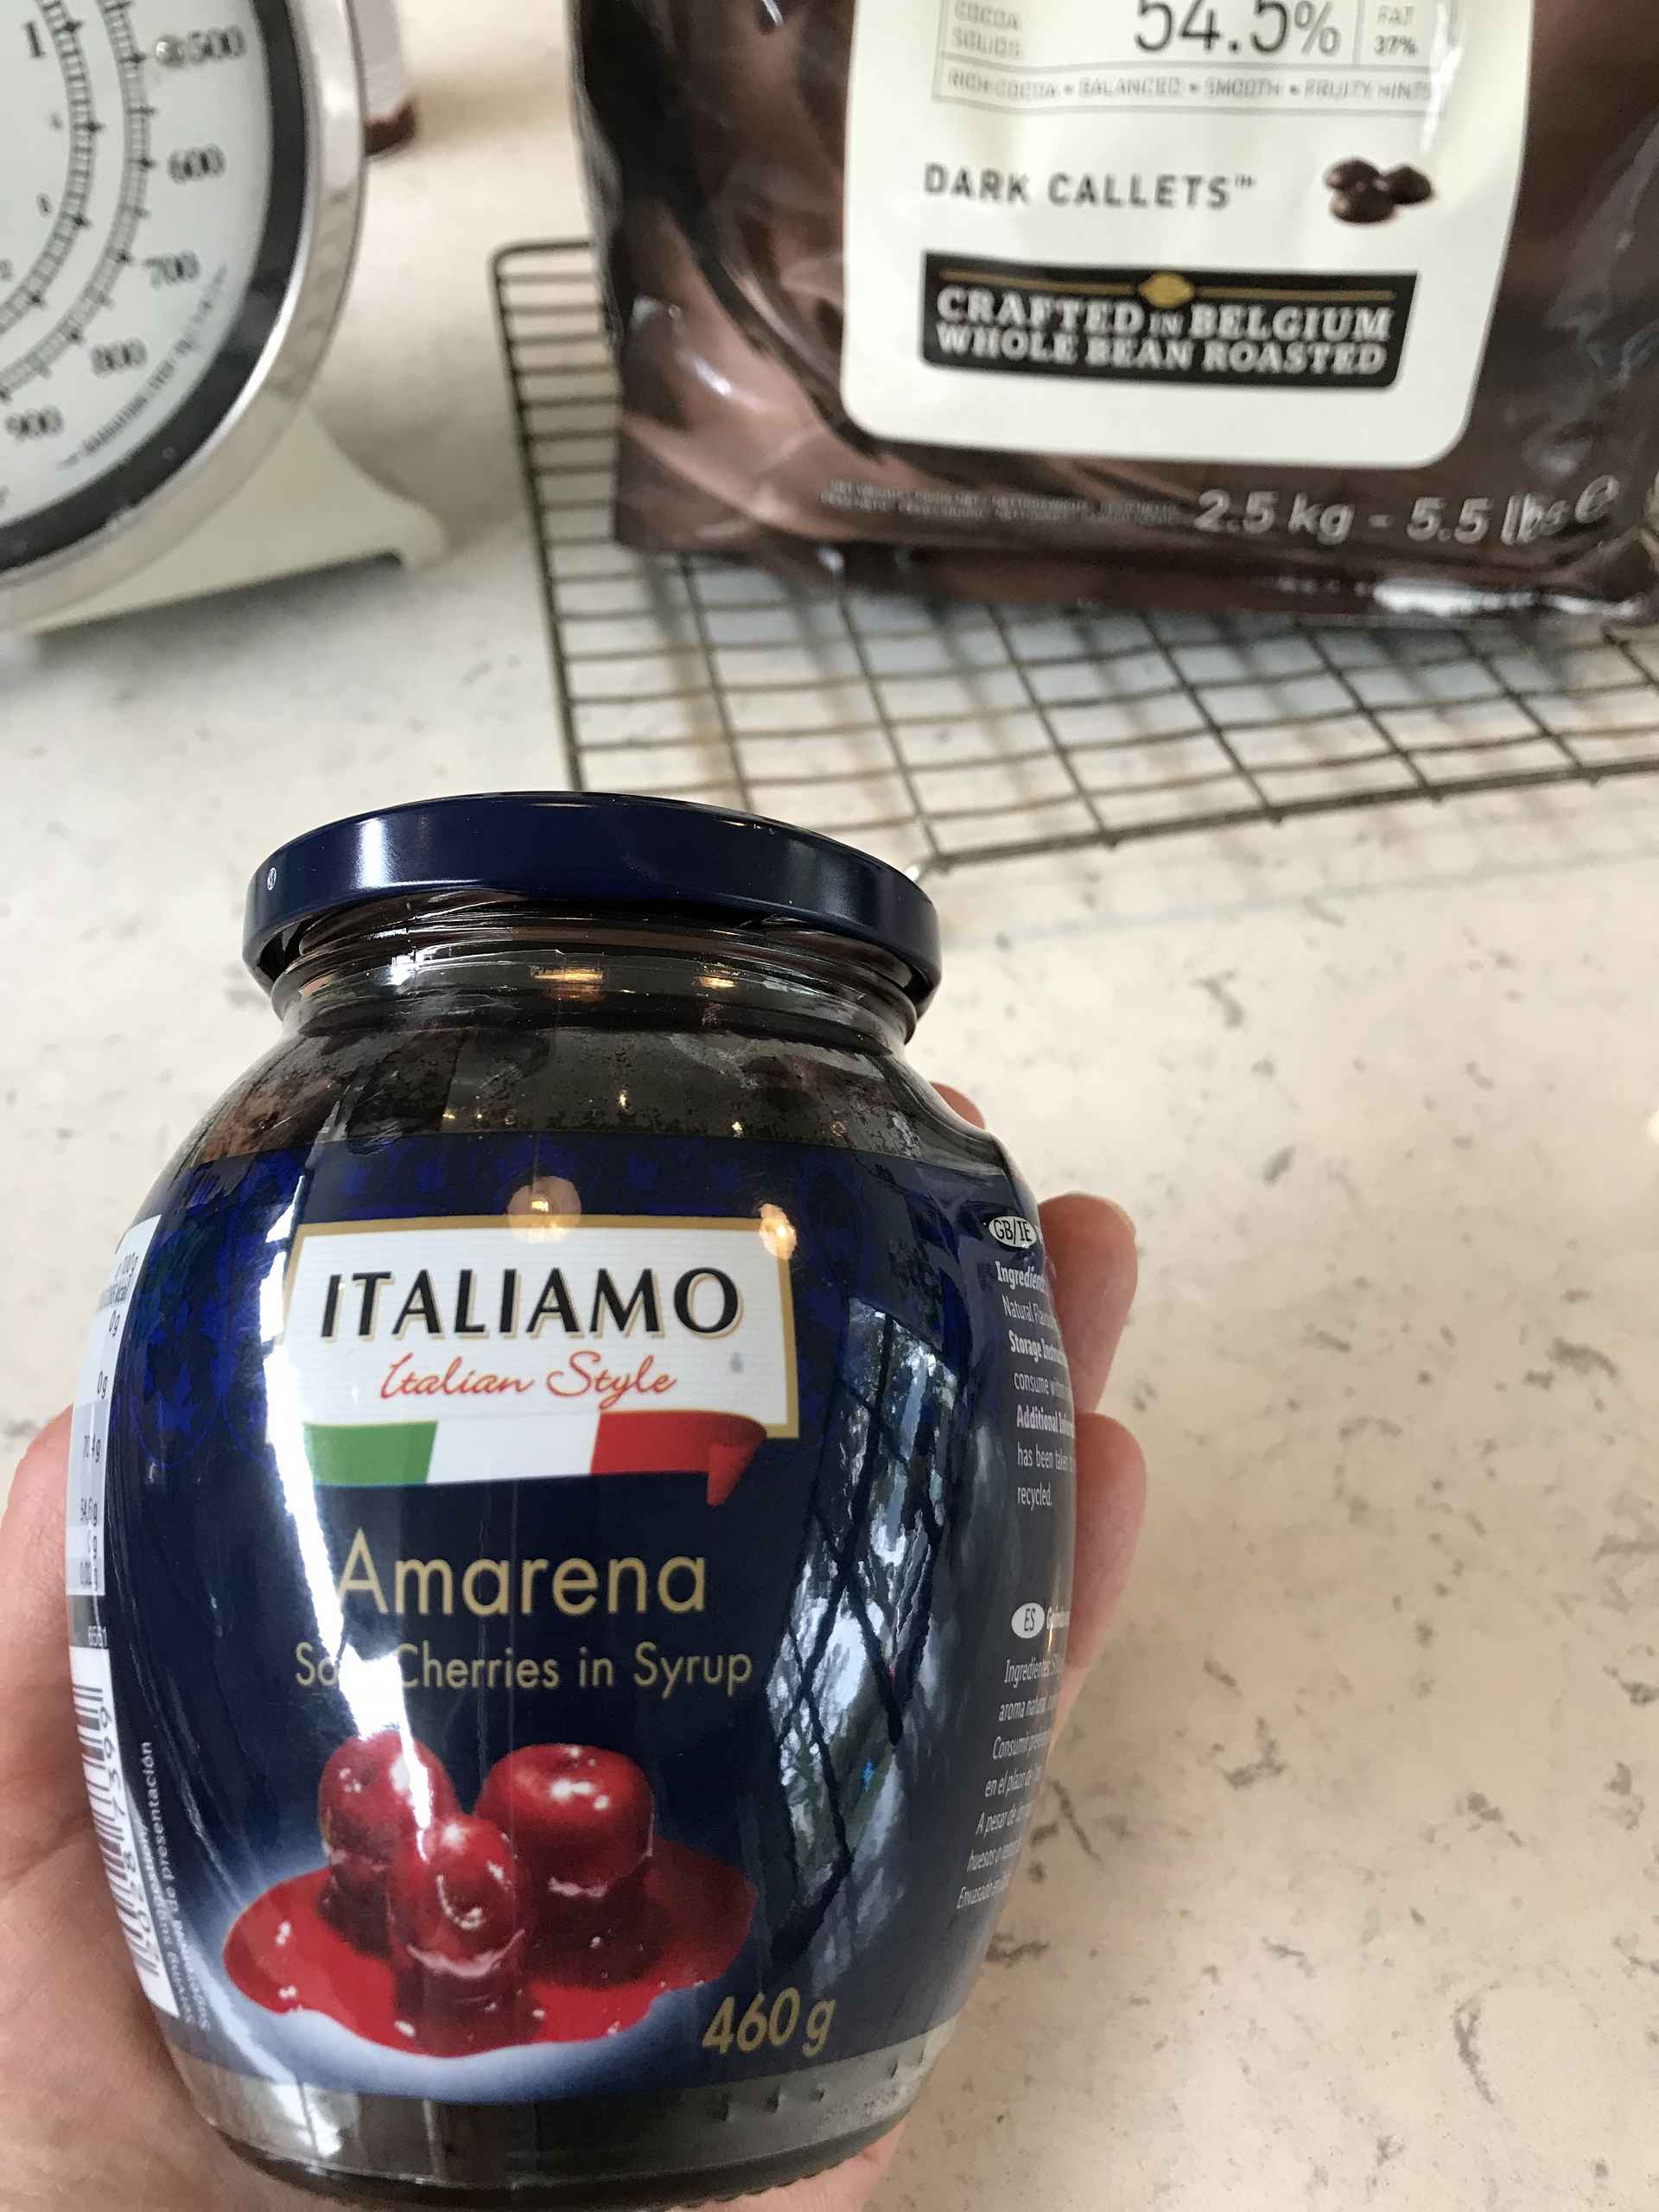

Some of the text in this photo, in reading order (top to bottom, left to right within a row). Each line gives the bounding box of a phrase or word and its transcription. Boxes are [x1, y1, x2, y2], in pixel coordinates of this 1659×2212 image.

[1135, 0, 1342, 54] 54.5%
[1374, 35, 1419, 56] 37%
[1079, 76, 1185, 98] BALANCED
[1204, 77, 1280, 97] SMOOTH
[168, 143, 226, 184] 600
[923, 162, 1029, 204] DARK
[937, 286, 1396, 343] CRAFTED IN BELGIUM
[936, 321, 1388, 375] WHOLE BEAN ROASTED
[1193, 489, 1279, 536] 2.5
[1287, 492, 1356, 545] kg
[1407, 497, 1493, 544] 5.5
[993, 1218, 1033, 1245] GB/IE
[320, 1265, 745, 1341] ITALIAMO
[1001, 1294, 1035, 1324] Natural
[1008, 1329, 1042, 1363] Storage
[380, 1350, 678, 1409] Italian Style
[1014, 1372, 1050, 1395] consume
[1016, 1404, 1058, 1434] Additional
[1017, 1441, 1033, 1467] has
[1036, 1443, 1053, 1470] been
[1017, 1483, 1053, 1511] recycled.
[338, 1527, 705, 1616] Amarena
[1023, 1607, 1036, 1631] ES
[397, 1641, 559, 1688] Cherries
[578, 1646, 613, 1687] in
[634, 1641, 753, 1700] Syrup
[998, 1700, 1026, 1722] aroma
[984, 1778, 997, 1798] en
[141, 1741, 175, 1881] presentación
[701, 1986, 836, 2057] 460g
